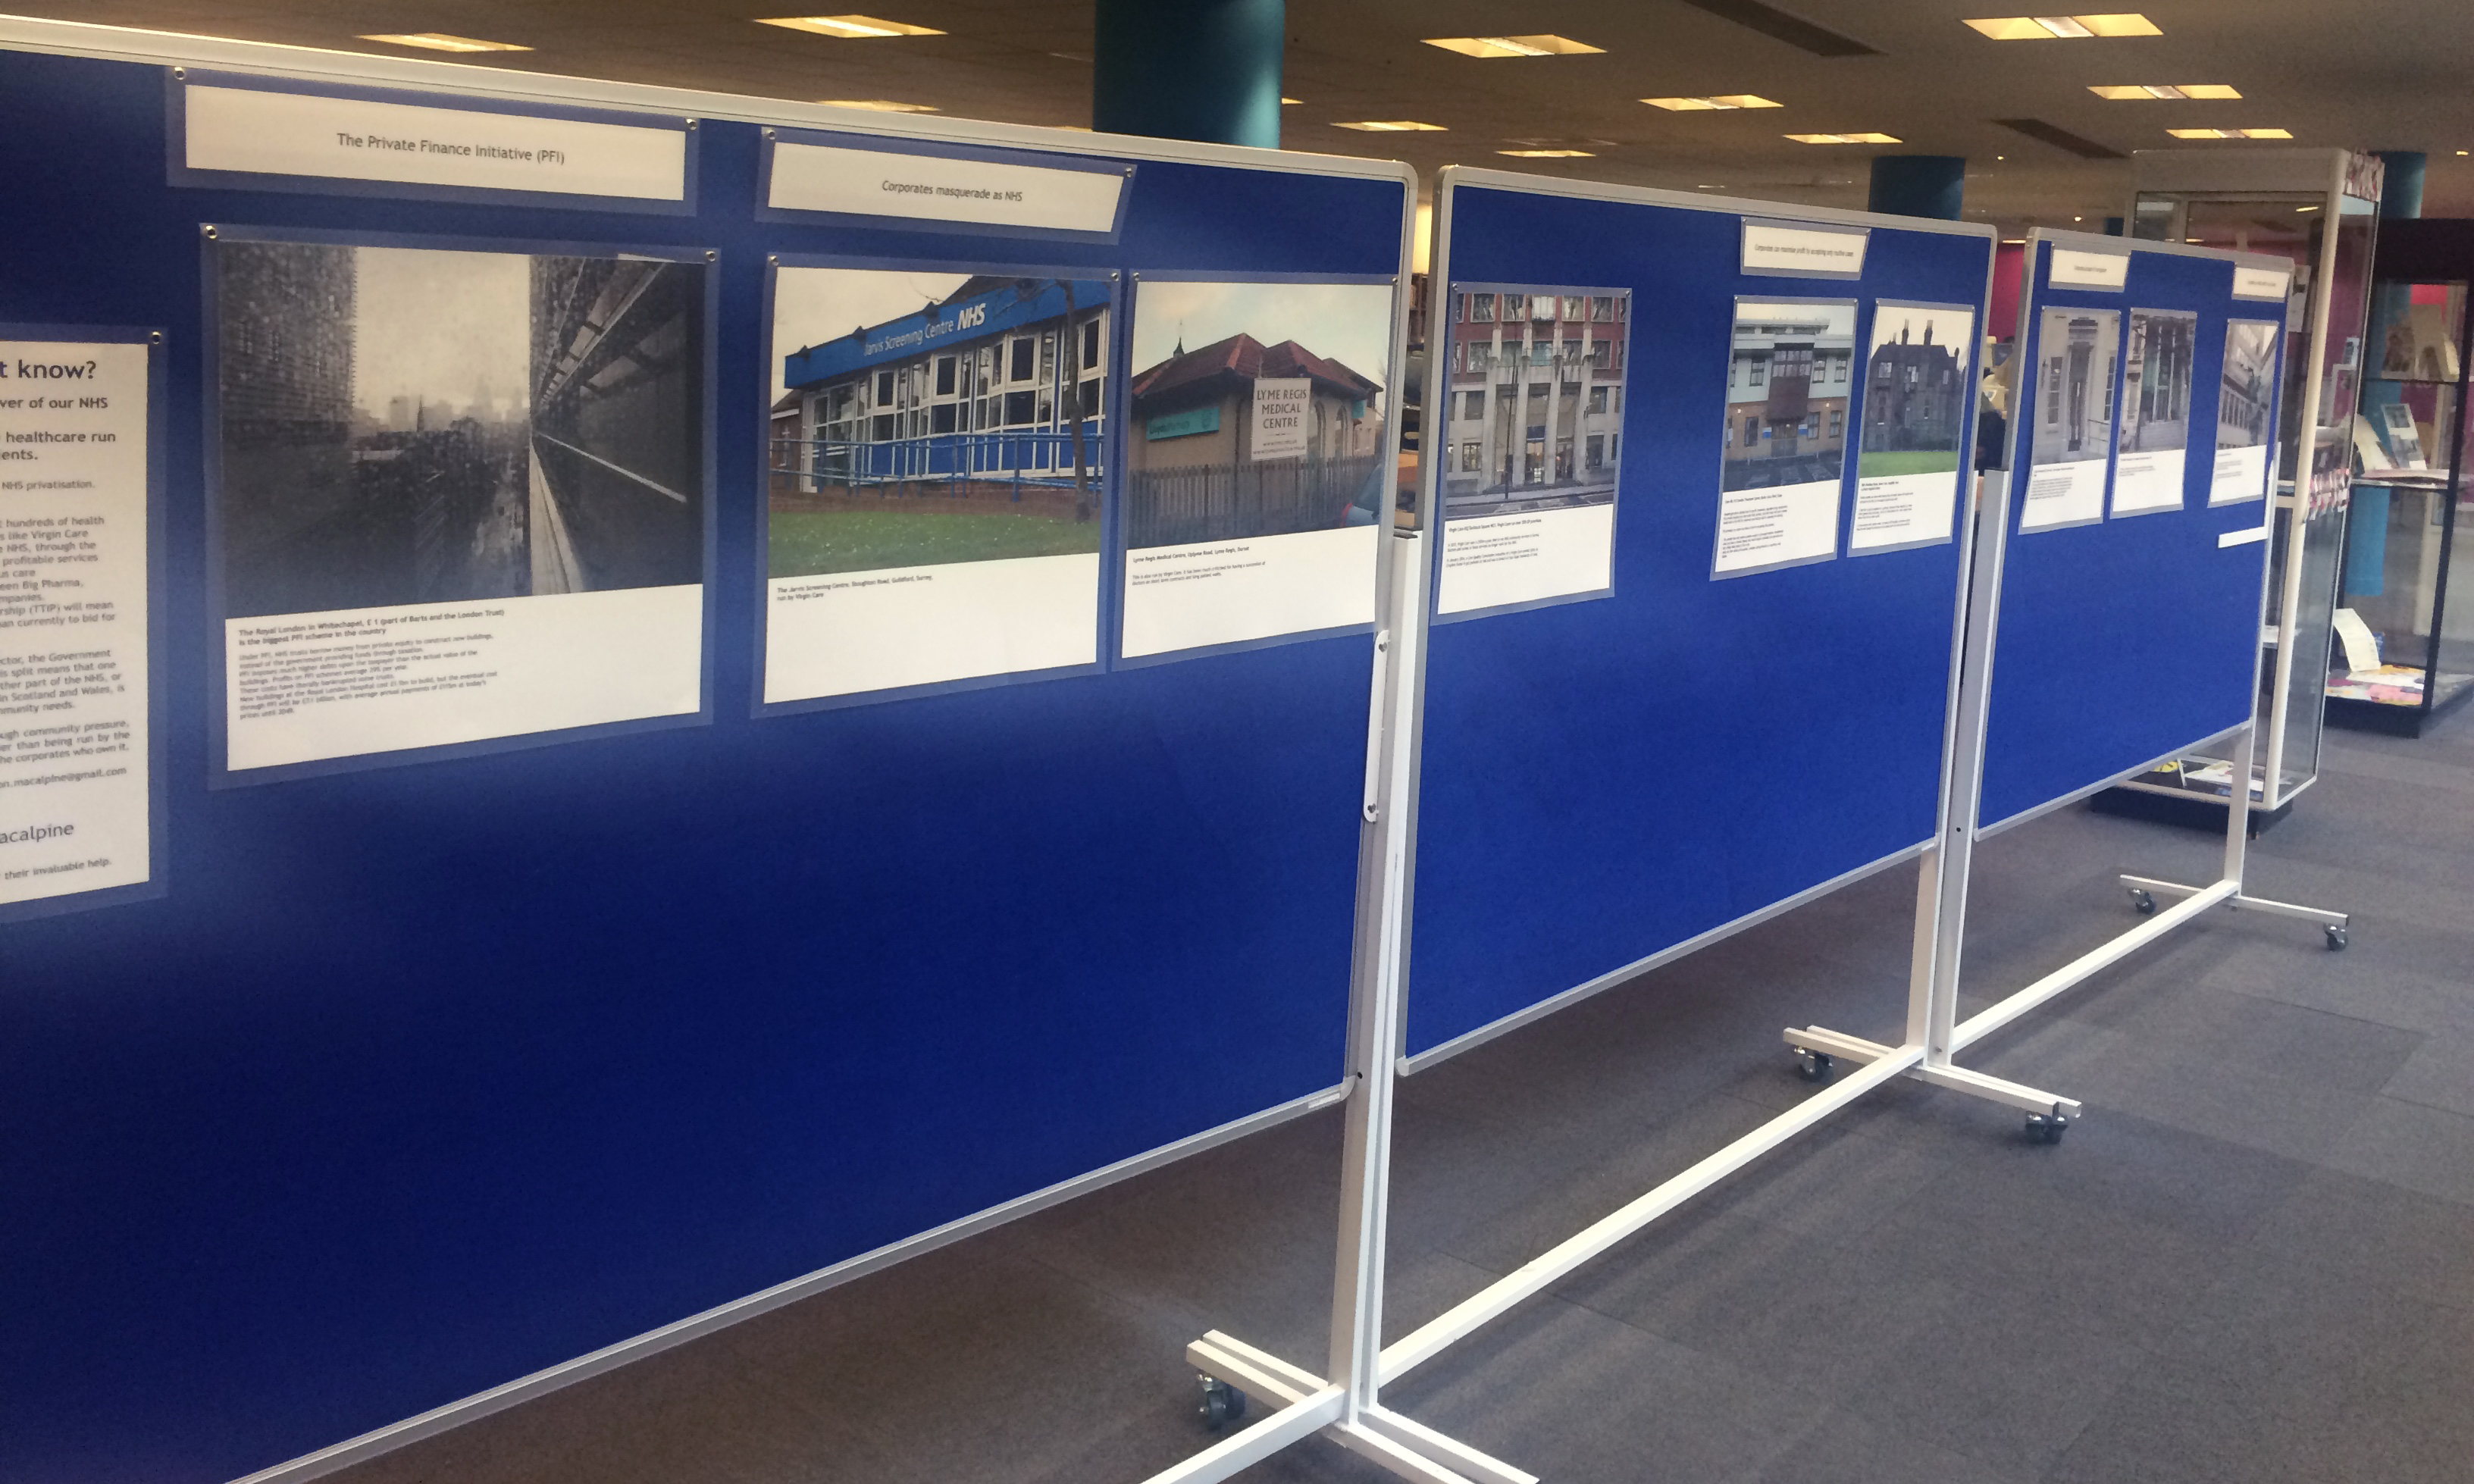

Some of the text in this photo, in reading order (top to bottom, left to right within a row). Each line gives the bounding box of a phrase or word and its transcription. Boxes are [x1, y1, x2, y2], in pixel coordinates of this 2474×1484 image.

[337, 133, 565, 165] The Private Finance Initiative (PFI)
[882, 180, 933, 194] Corporates
[935, 186, 991, 199] masquerade
[1004, 191, 1023, 202] NHS
[864, 303, 987, 356] Jarvis Screening Centre NHS
[18, 359, 97, 379] know?
[1257, 389, 1307, 400] LYME REGIS
[29, 397, 44, 409] of
[49, 399, 74, 409] our
[79, 396, 109, 409] NHS
[1261, 402, 1301, 415] MEDICAL
[1263, 417, 1298, 429] CENTRE
[6, 431, 86, 443] healthcare
[91, 432, 117, 443] run
[2, 480, 96, 491] NHS privatisation.
[6, 518, 55, 528] hundreds
[58, 517, 68, 526] of
[72, 515, 105, 525] health
[31, 531, 61, 541] Virgin
[65, 529, 89, 538] Care
[36, 541, 76, 553] through
[80, 541, 97, 549] the
[2, 553, 99, 567] profitable services
[17, 616, 65, 627] currently
[68, 615, 80, 624] to
[83, 614, 99, 623] bid
[102, 613, 116, 621] for
[28, 654, 45, 663] the
[49, 650, 111, 662] Government
[37, 665, 70, 675] means
[74, 662, 94, 672] that
[97, 662, 117, 670] one
[25, 678, 46, 690] part
[50, 676, 61, 686] of
[64, 675, 82, 685] the
[11, 688, 57, 702] Scotland
[59, 687, 79, 697] and
[23, 724, 80, 737] community
[17, 741, 40, 750] than
[45, 737, 73, 747] being
[77, 735, 94, 744] run
[98, 734, 110, 743] by
[114, 731, 130, 740] the
[15, 750, 70, 762] corporates
[73, 747, 94, 756] who
[96, 745, 117, 753] own
[0, 823, 74, 844] acalpine
[5, 871, 30, 880] their
[33, 862, 85, 875] invaluable
